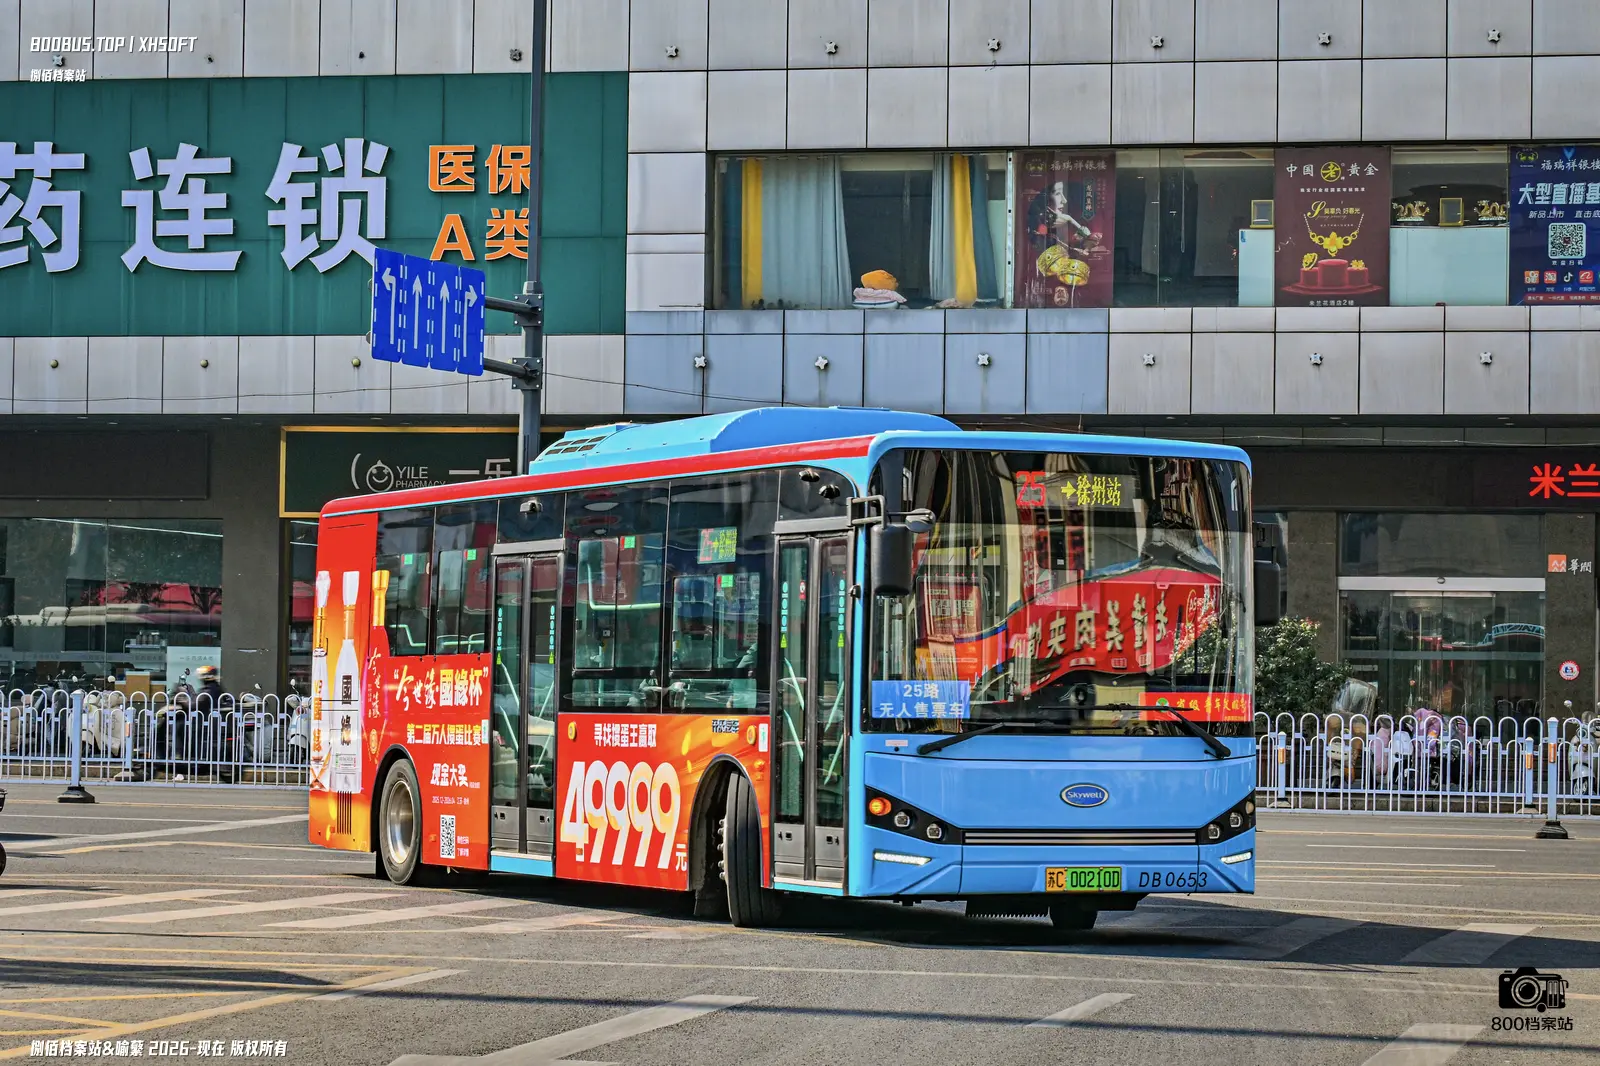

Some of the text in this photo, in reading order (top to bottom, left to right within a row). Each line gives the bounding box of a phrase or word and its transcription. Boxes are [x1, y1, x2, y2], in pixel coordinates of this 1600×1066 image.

[428, 144, 530, 194] 医保
[1518, 182, 1600, 205] 大型直播基
[430, 208, 530, 261] A类
[396, 466, 429, 479] YILE
[1529, 463, 1600, 499] 米兰
[1016, 471, 1121, 506] 25 徐州站
[903, 683, 939, 699] 25路
[879, 702, 964, 718] 无人售票车
[430, 763, 469, 787] 现金大奖
[1067, 791, 1103, 800] Skywell
